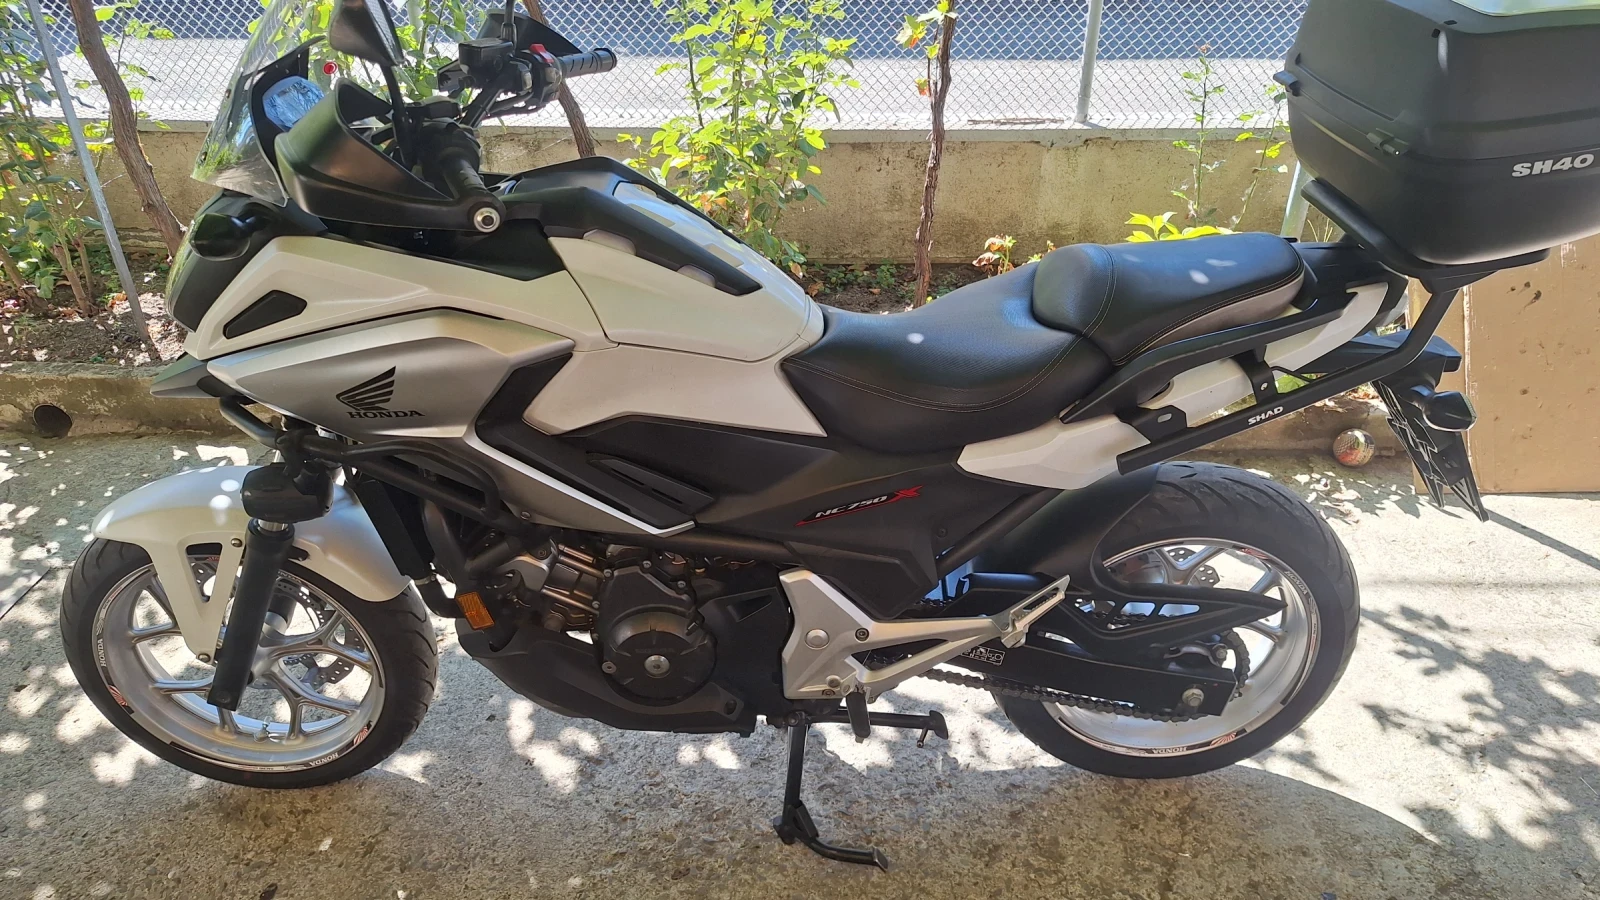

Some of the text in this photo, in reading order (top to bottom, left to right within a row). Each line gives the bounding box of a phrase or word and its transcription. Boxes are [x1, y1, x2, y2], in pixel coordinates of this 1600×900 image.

[1511, 153, 1595, 177] SH40
[346, 410, 426, 419] HONDA
[1247, 406, 1284, 425] SHAD
[1283, 570, 1309, 595] HONDA
[97, 638, 107, 667] HONDA
[308, 752, 339, 767] HONDA
[1151, 746, 1188, 754] HONDA
